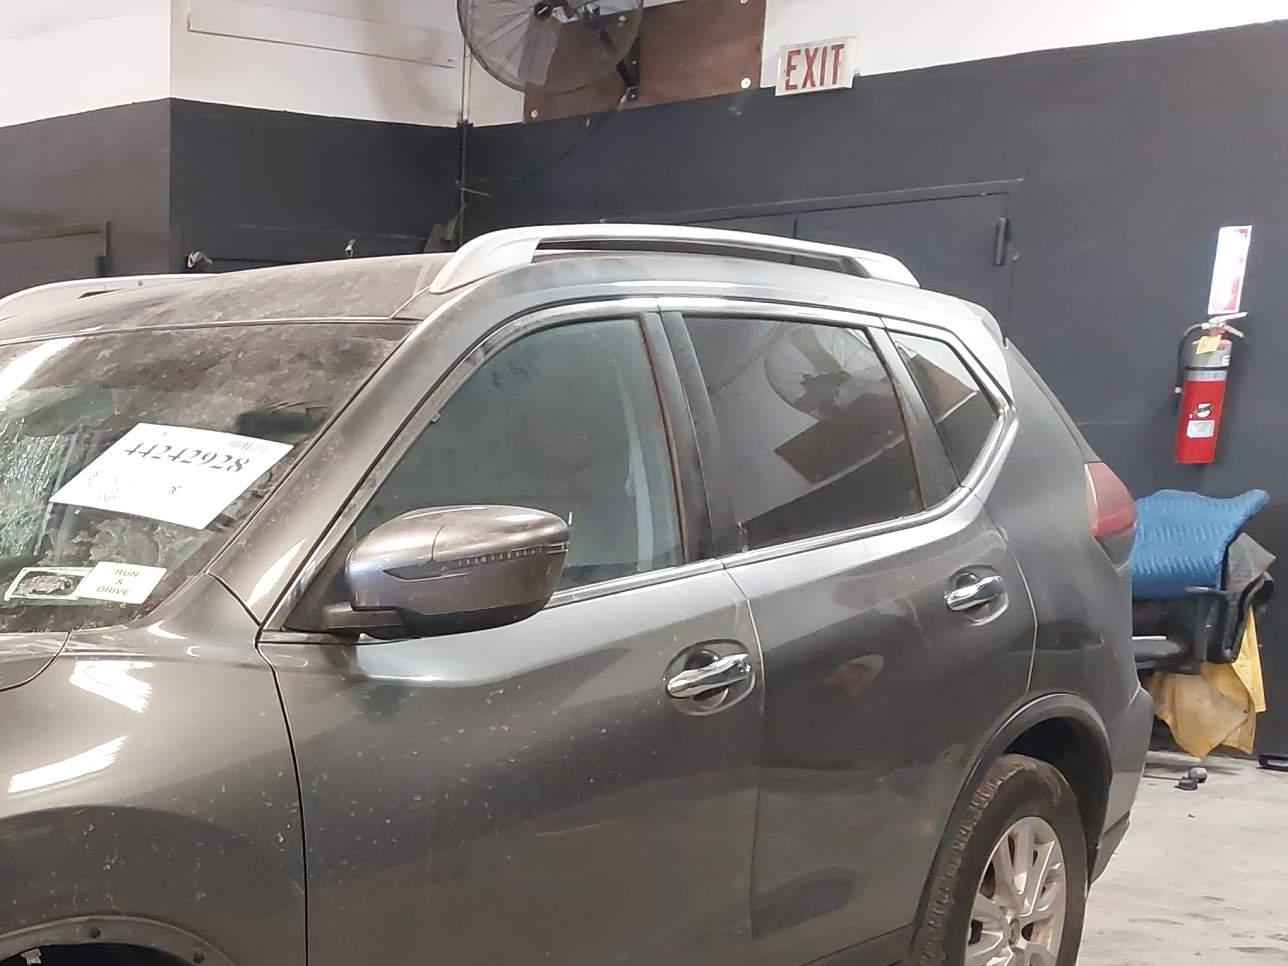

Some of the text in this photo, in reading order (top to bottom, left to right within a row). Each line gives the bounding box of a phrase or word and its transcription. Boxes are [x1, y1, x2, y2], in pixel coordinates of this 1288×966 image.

[785, 43, 845, 91] EXIT
[124, 442, 250, 473] 44242928
[114, 568, 141, 578] RUN
[95, 586, 130, 597] DRIVE
